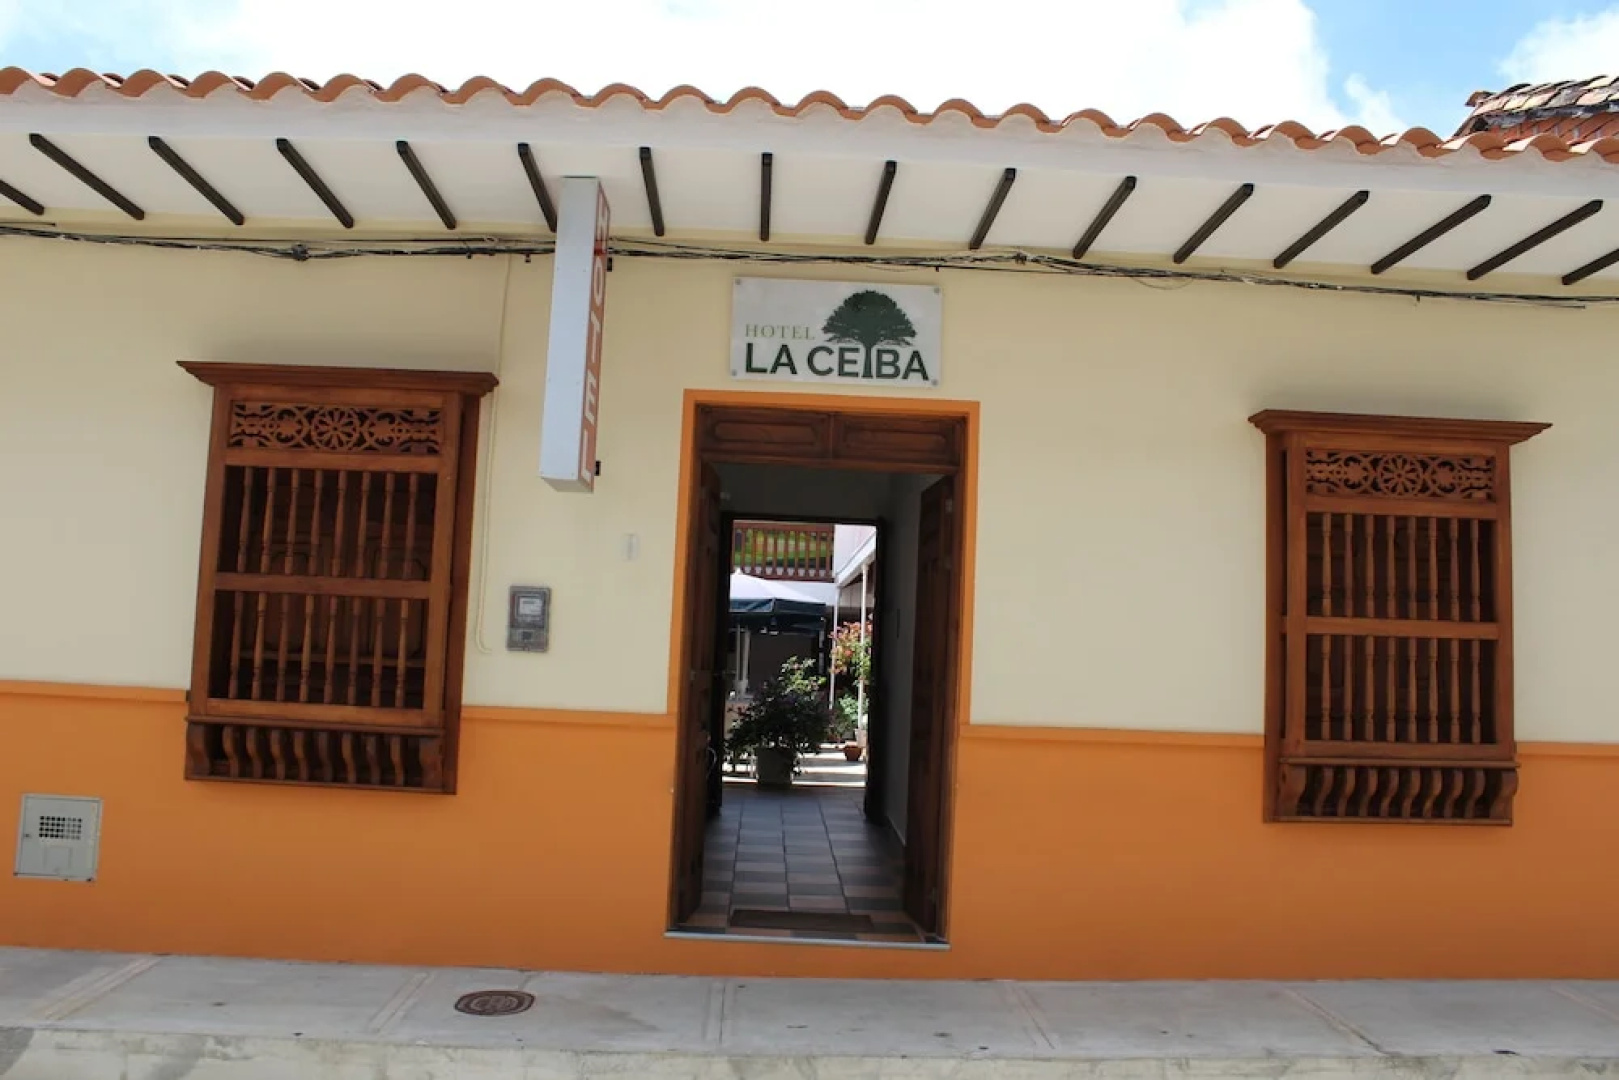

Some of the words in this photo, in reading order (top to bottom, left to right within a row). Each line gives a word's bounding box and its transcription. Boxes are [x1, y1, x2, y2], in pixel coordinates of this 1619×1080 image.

[580, 187, 608, 482] HOTEL
[744, 323, 816, 340] HOTEL
[745, 342, 798, 375] LA
[807, 345, 930, 381] CEIBA
